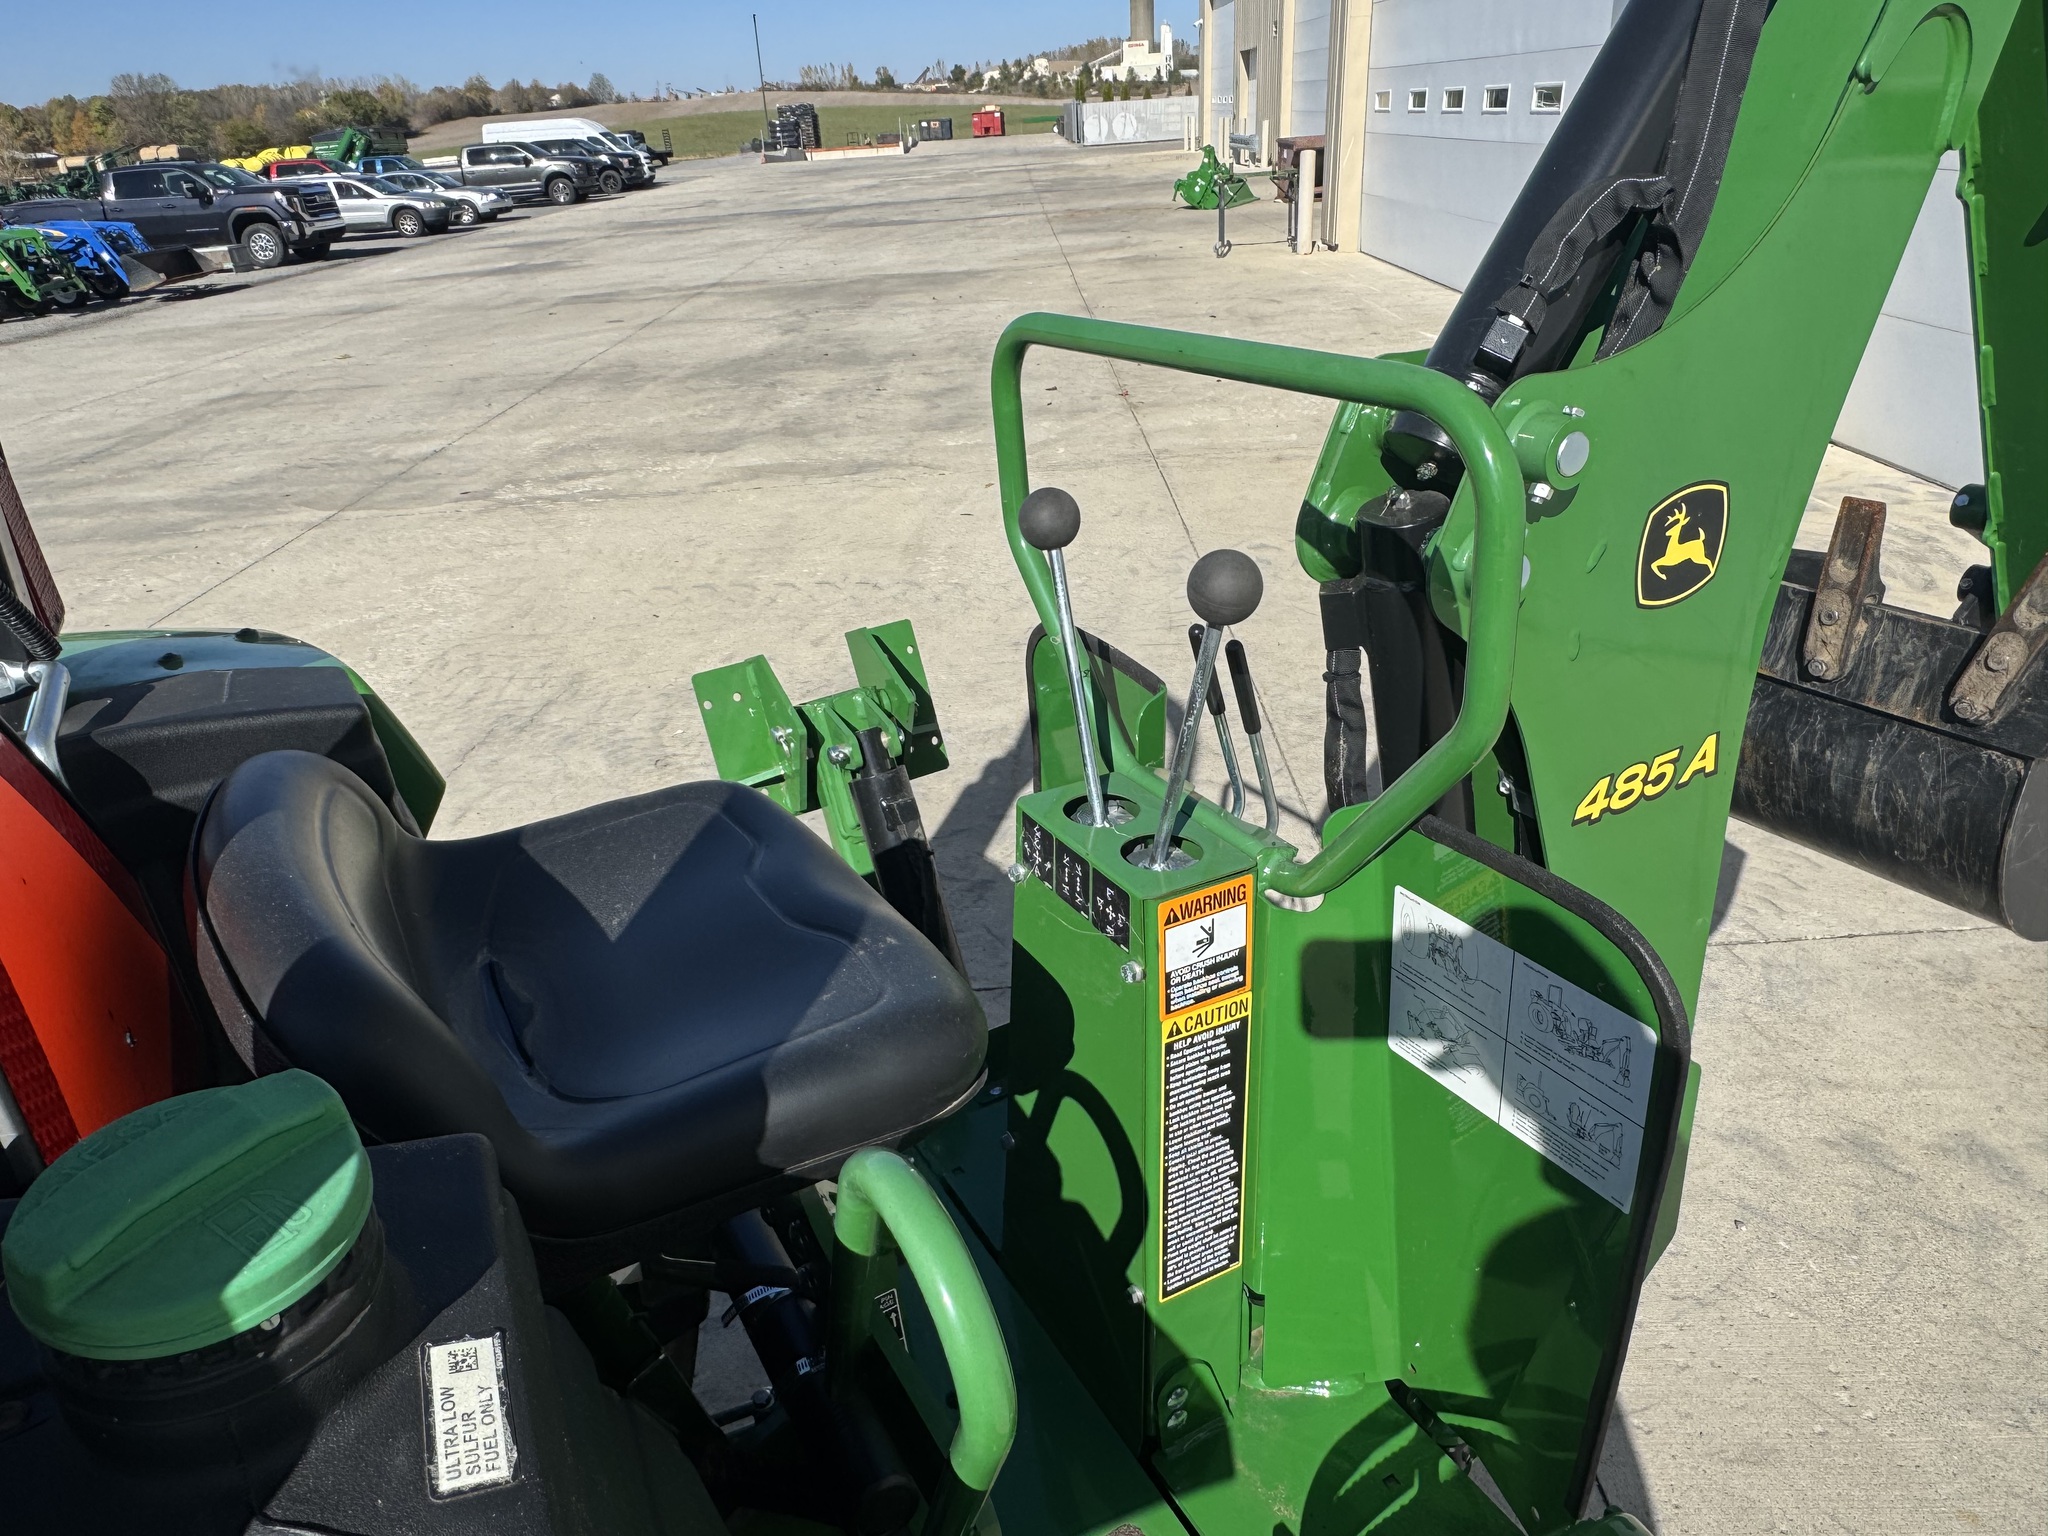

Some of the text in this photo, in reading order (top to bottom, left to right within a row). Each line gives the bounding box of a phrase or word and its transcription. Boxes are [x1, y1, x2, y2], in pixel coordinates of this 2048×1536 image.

[1180, 884, 1247, 920] WARNING
[1170, 949, 1238, 978] AVOID CRUSH INJURY
[1170, 968, 1204, 985] OR DEATH
[1184, 997, 1249, 1033] CAUTION
[1173, 1020, 1240, 1050] HELP AVOID INJURY
[440, 1386, 462, 1482] ULTRA LOW
[461, 1409, 481, 1476] SULFUR
[478, 1385, 501, 1473] FUEL ONLY
